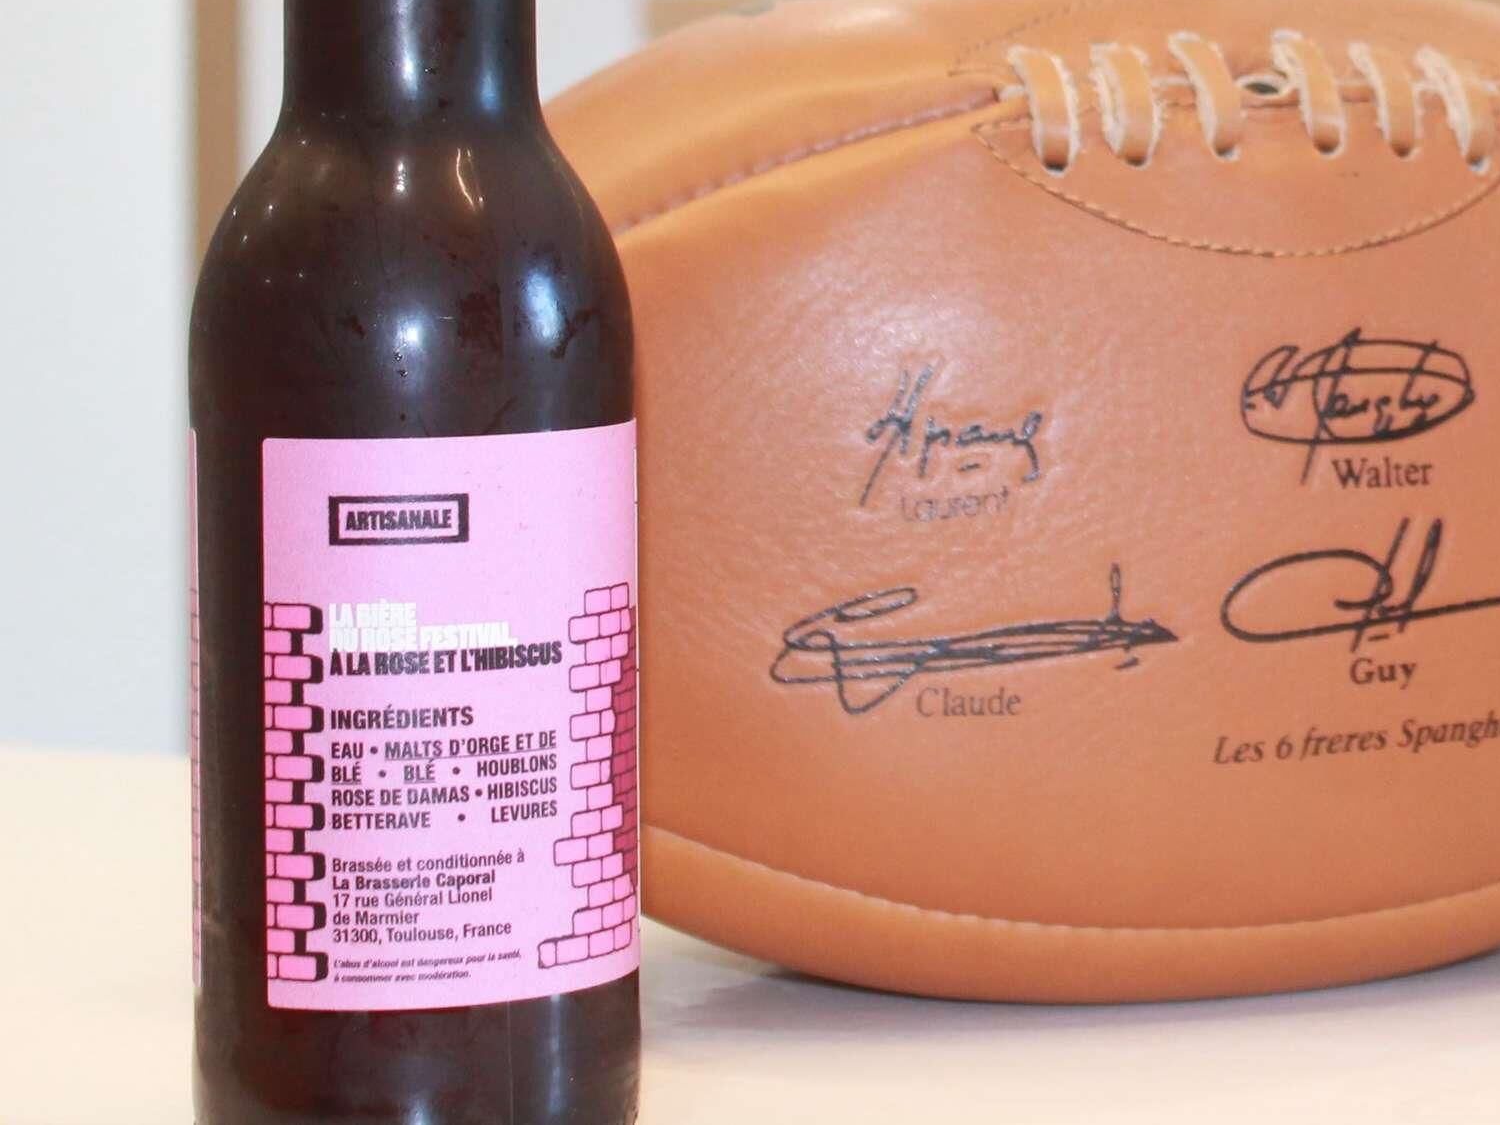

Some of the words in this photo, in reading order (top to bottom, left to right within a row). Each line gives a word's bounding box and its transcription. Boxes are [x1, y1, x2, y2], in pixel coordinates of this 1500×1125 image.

[1331, 456, 1432, 489] Walter
[345, 508, 452, 531] ARTISANALE
[329, 602, 354, 627] LA
[356, 596, 417, 628] BIÈRE
[329, 627, 359, 652] DU
[361, 627, 417, 652] ROSE
[330, 648, 343, 676] À
[346, 651, 371, 676] LA
[374, 651, 430, 676] ROSE
[433, 650, 457, 674] ET
[461, 640, 562, 672] L'HIBISCUS
[1349, 657, 1417, 687] Guy
[915, 687, 1022, 718] Claude
[330, 705, 474, 730] INGRÉDIENTS
[331, 742, 364, 759] EAU
[384, 740, 443, 759] MALTS
[449, 734, 510, 756] D'ORGE
[515, 733, 534, 751] ET
[538, 730, 557, 749] DE
[1213, 735, 1265, 764] Les
[1275, 734, 1294, 760] 6
[331, 761, 362, 783] BLÉ
[403, 760, 436, 782] BLÉ
[476, 753, 557, 777] HOUBLONS
[331, 789, 375, 807] ROSE
[380, 789, 402, 806] DE
[407, 785, 470, 805] DAMAS
[487, 776, 557, 800] HIBISCUS
[331, 811, 431, 830] BETTERAVE
[491, 800, 558, 823] LEVURES
[332, 857, 392, 873] Brassée
[397, 857, 412, 872] et
[416, 850, 513, 871] conditionnée
[517, 848, 525, 863] à
[332, 876, 349, 891] La
[355, 875, 431, 891] Brasserie
[436, 870, 496, 889] Caporal
[333, 894, 350, 908] 17
[355, 895, 379, 908] rue
[384, 891, 444, 908] Général
[448, 887, 493, 905] Lionel
[333, 910, 350, 925] de
[355, 910, 419, 925] Marmier
[333, 929, 382, 945] 31300,
[386, 927, 459, 943] Toulouse,
[463, 923, 512, 939] France
[465, 954, 486, 965] pour
